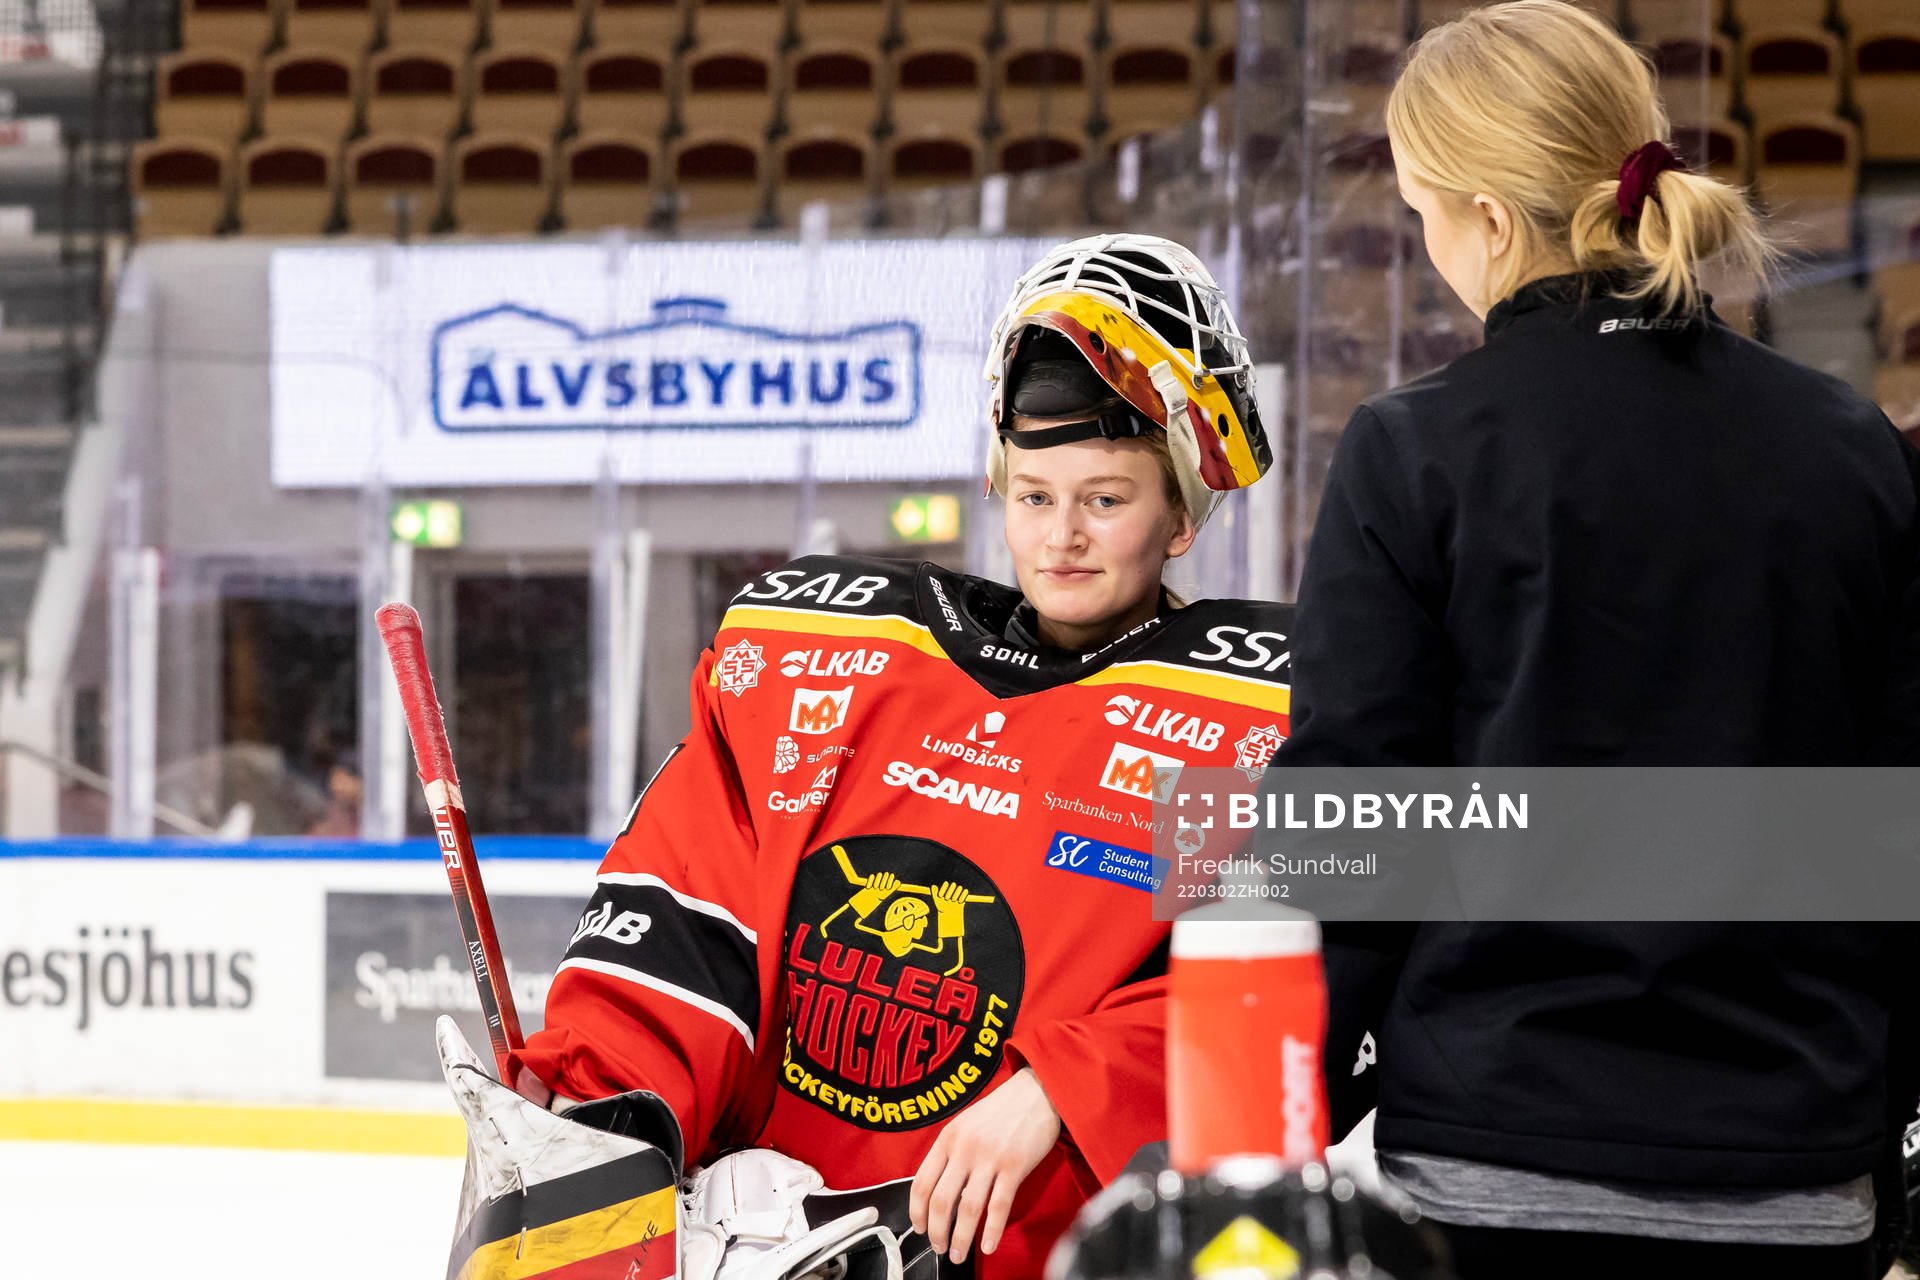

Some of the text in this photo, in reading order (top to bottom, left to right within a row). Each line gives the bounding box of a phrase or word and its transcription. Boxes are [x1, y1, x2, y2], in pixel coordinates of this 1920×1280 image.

[1598, 317, 1690, 334] BAUER
[460, 350, 897, 409] ÄLVSBYHUS
[928, 576, 963, 632] BAUER
[808, 648, 890, 677] LKAB
[979, 644, 1040, 670] SDHL
[1132, 702, 1225, 753] LKAB
[921, 734, 1022, 774] LINDBÄCKS
[1106, 754, 1174, 799] MAX
[882, 760, 1021, 820] SCANIA
[1042, 790, 1164, 835] Sparbanken Nord
[1098, 860, 1162, 890] Consulting
[1102, 848, 1150, 871] Student
[2, 926, 255, 1031] esjöhus
[468, 940, 489, 982] AXELL
[788, 922, 979, 1022] LULEÅ
[787, 970, 967, 1090] HOCKEY
[974, 993, 1009, 1059] 1977
